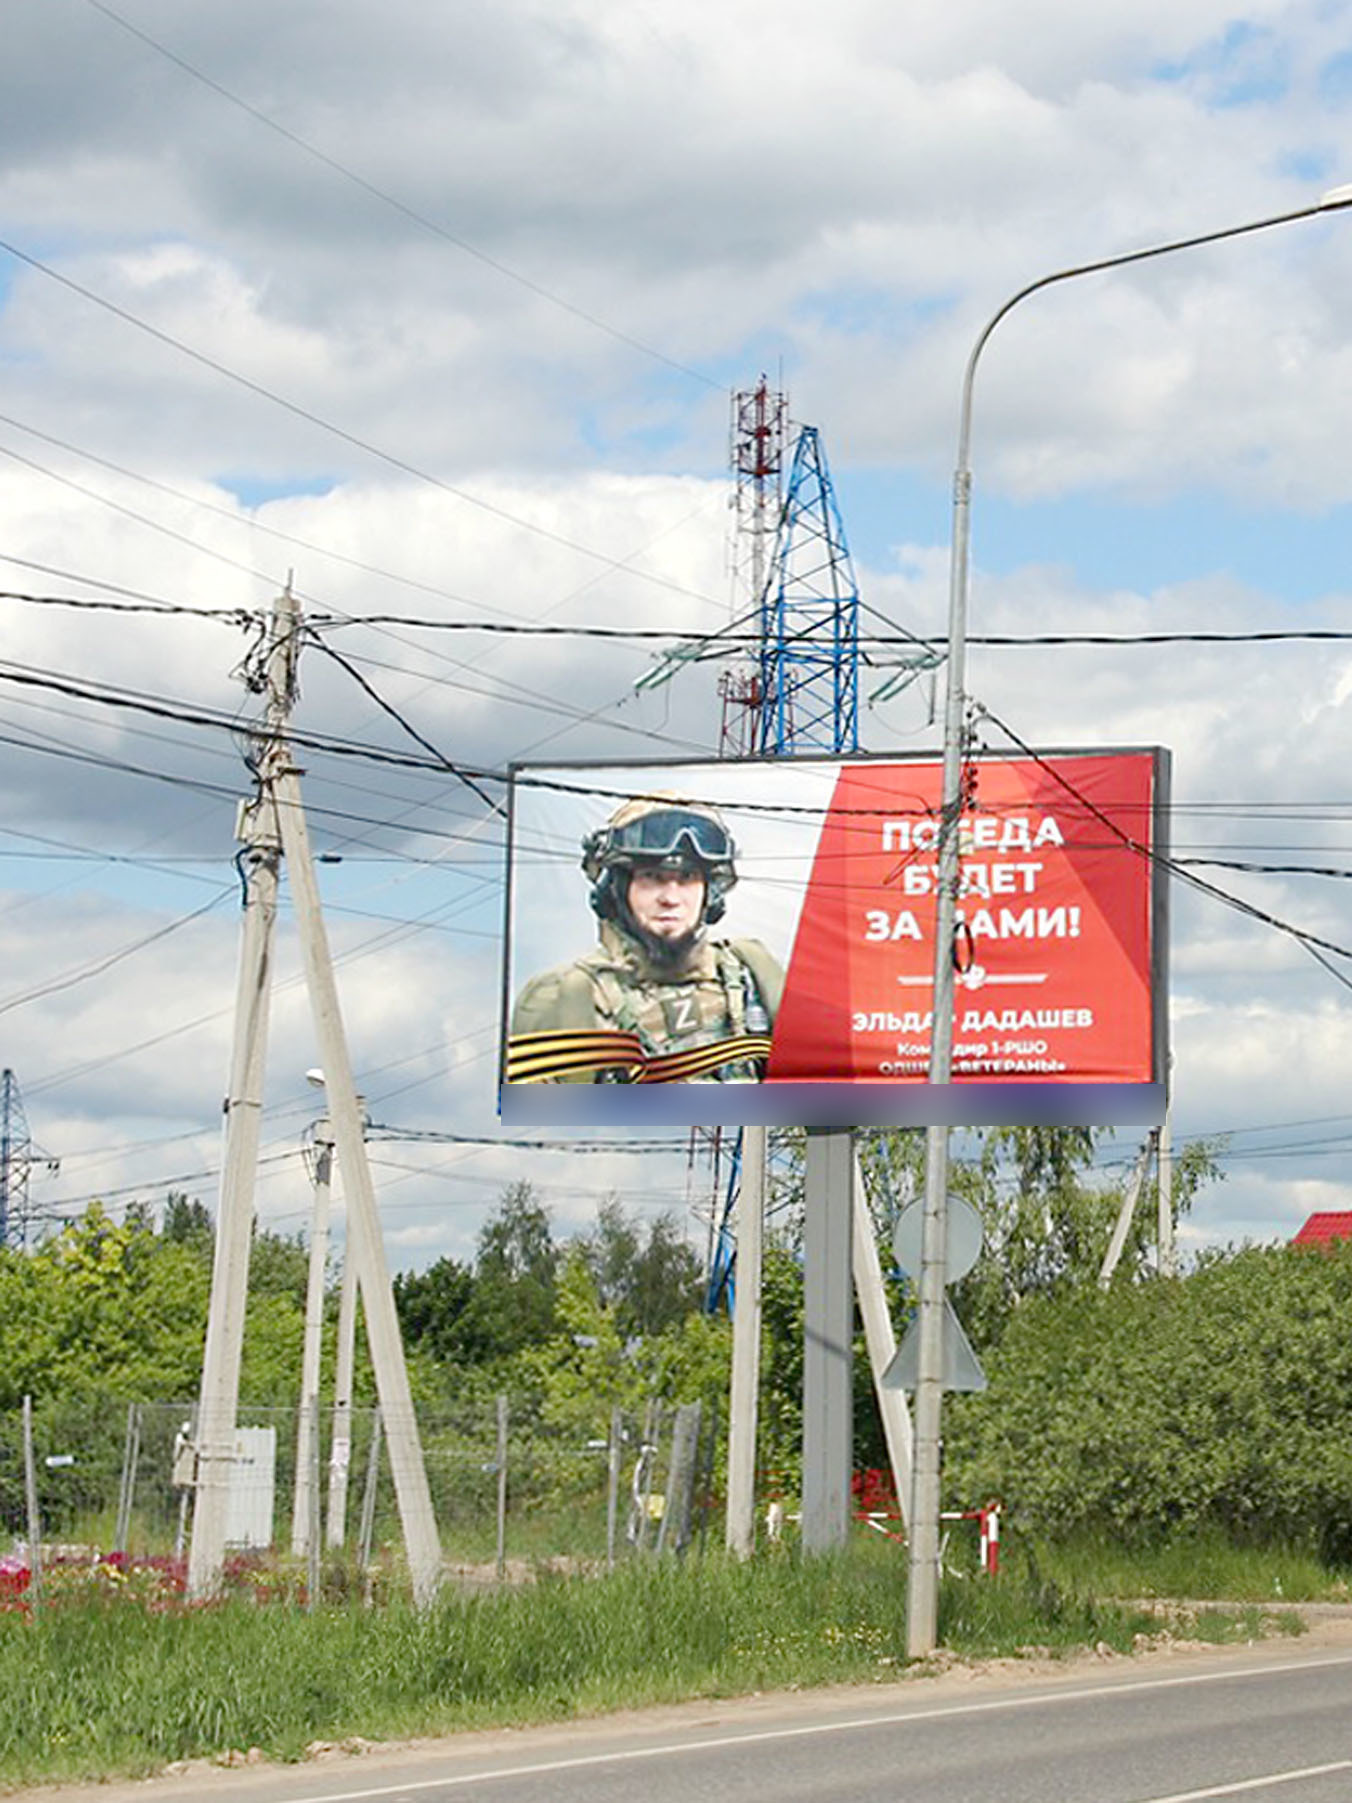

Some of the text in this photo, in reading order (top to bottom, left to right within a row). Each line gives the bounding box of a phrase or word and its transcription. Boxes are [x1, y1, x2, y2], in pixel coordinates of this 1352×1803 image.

[903, 862, 1043, 900] БДЕТ
[864, 910, 923, 941] ЗА
[673, 998, 697, 1030] Z
[852, 1009, 1094, 1032] ЭЛЬДА ДАДАШЕВ
[897, 1041, 988, 1057] Комдир
